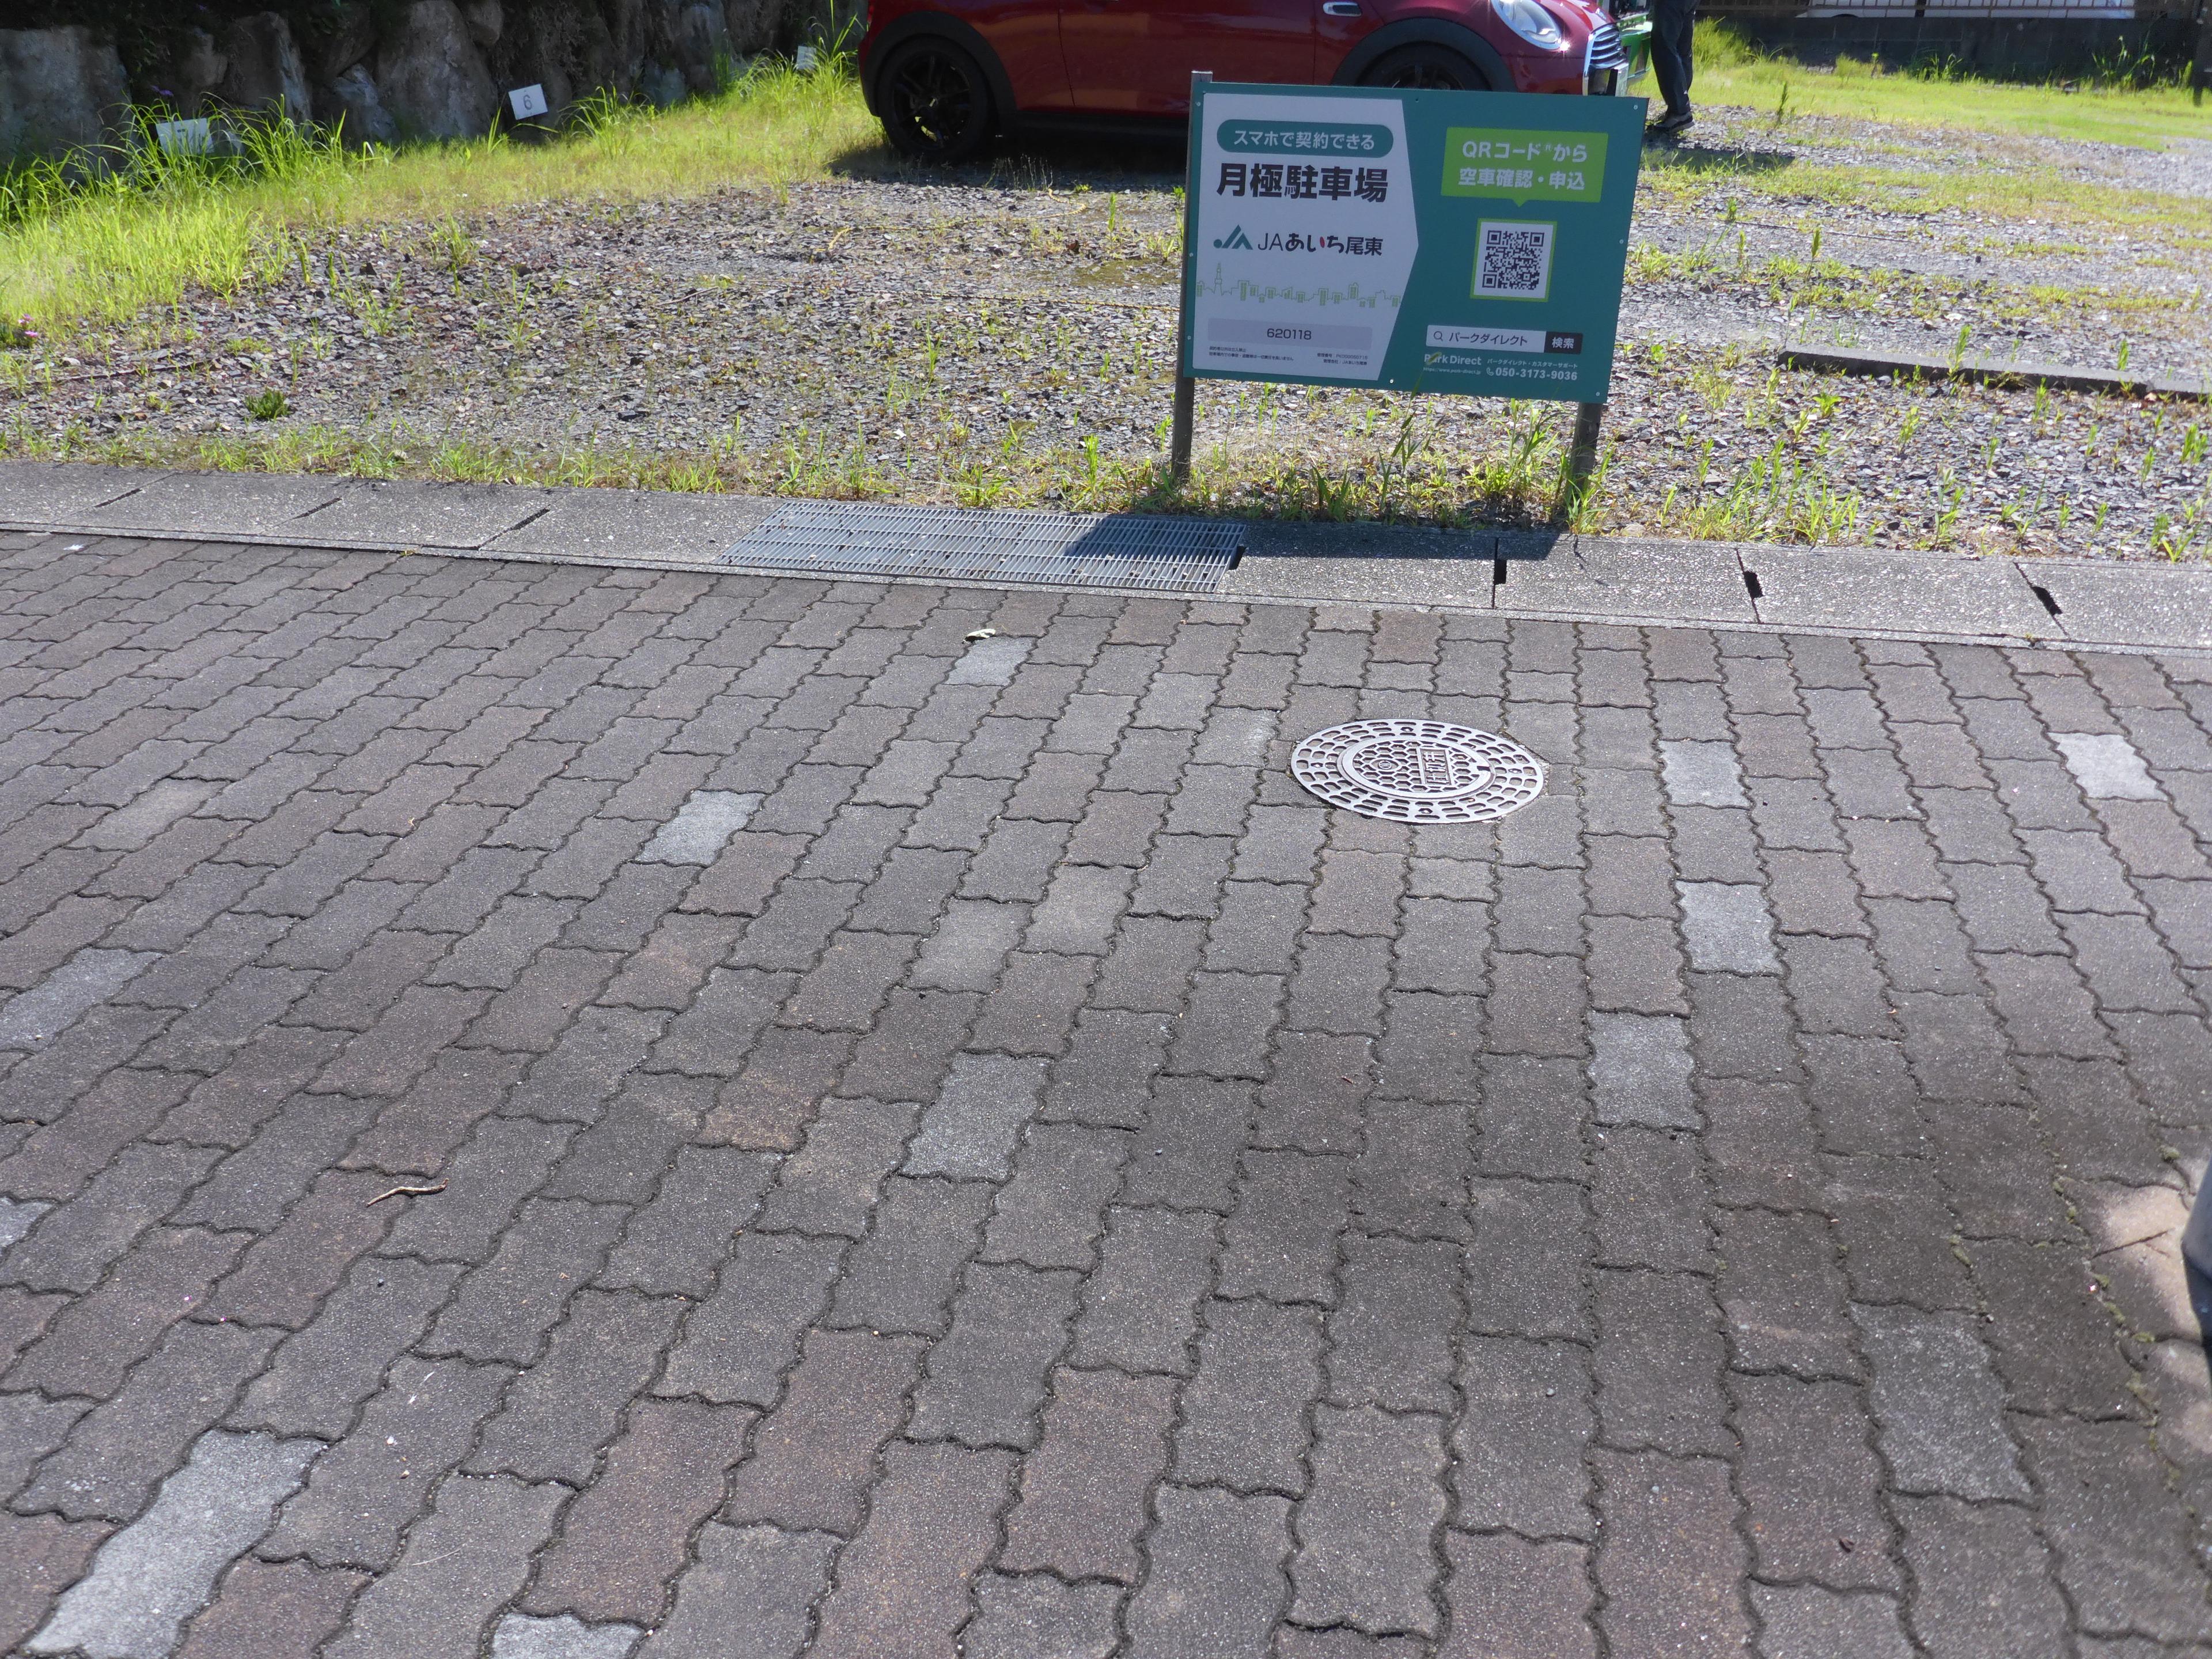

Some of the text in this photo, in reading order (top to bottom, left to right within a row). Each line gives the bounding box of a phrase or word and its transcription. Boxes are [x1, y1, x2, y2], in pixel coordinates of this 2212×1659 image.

[523, 94, 532, 110] 6
[1234, 130, 1375, 150] スマホで契約できる
[1217, 162, 1388, 203] 月極駐車場
[1458, 168, 1585, 191] 空車確認・申込
[1257, 233, 1384, 256] JAあいち尾東
[1267, 328, 1312, 340] 620118
[1449, 332, 1575, 350] パークダイレクト 検索
[1449, 355, 1482, 365] Direct
[1495, 367, 1578, 381] 050-3173-9036
